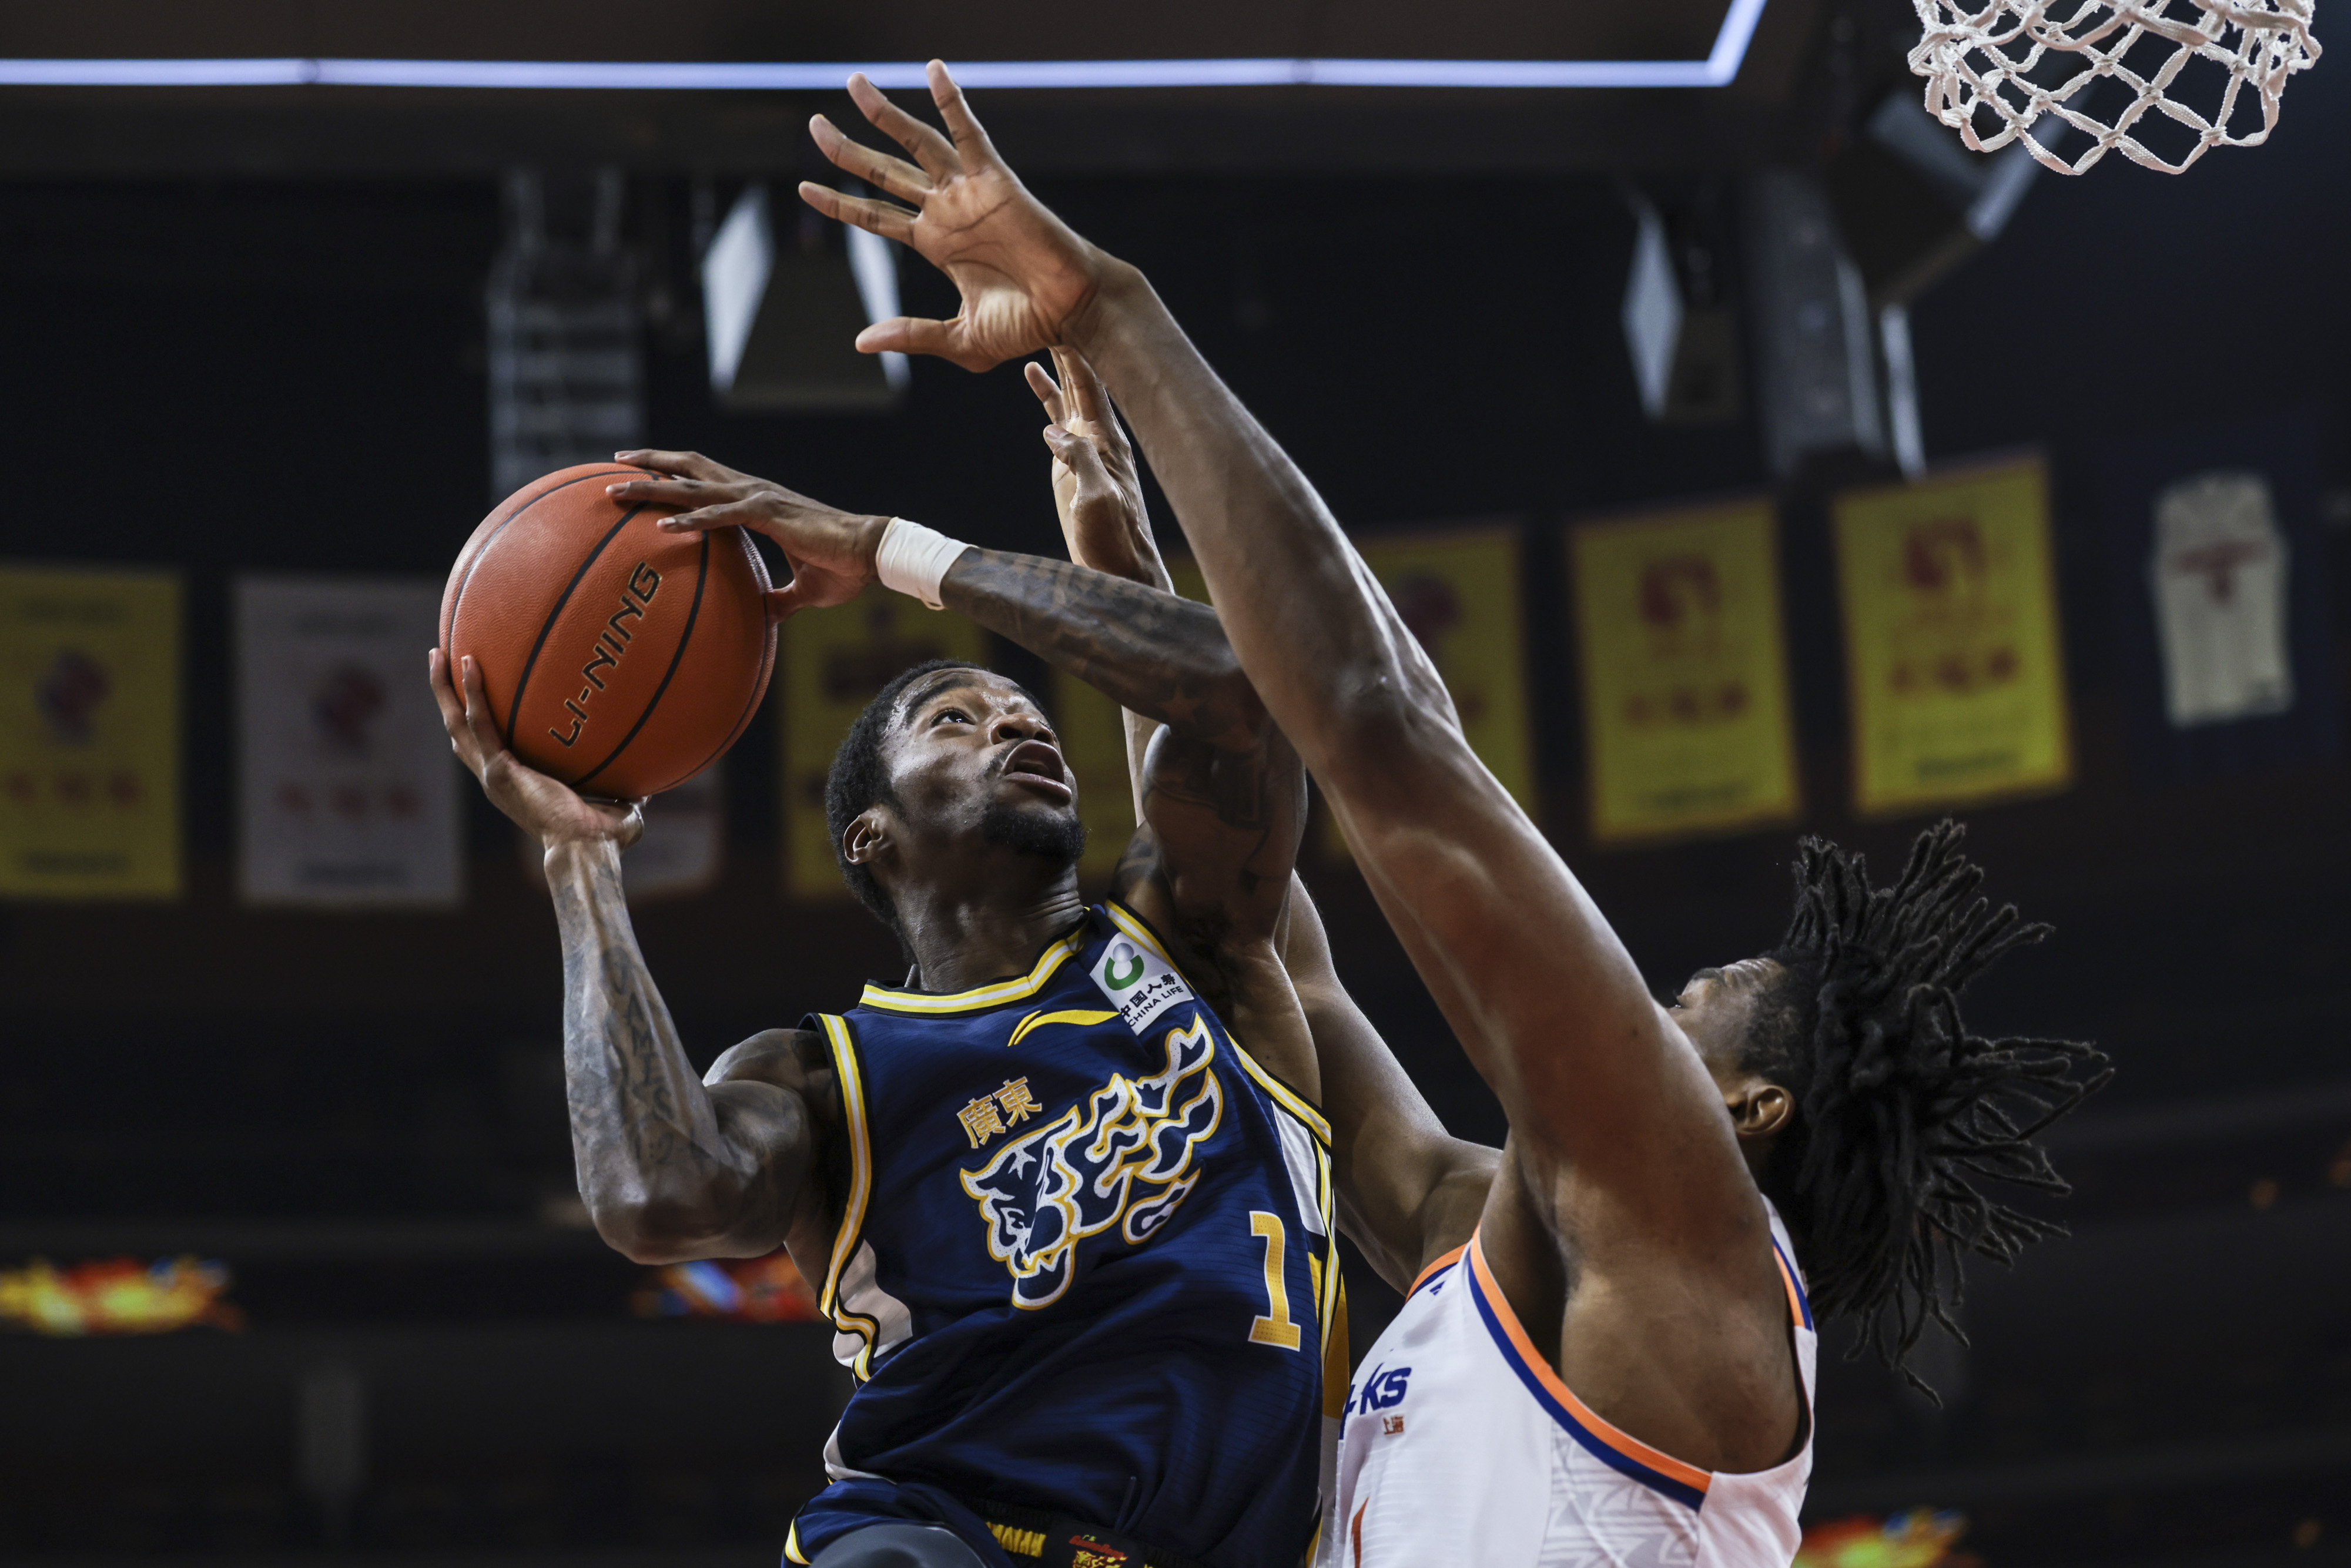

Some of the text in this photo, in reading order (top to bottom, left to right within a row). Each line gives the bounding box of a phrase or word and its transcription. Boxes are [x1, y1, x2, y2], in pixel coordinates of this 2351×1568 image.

[548, 560, 662, 749] LI-NING
[1120, 973, 1176, 1018] 中国人寿
[1127, 986, 1184, 1027] CHINA LIFE
[956, 1076, 1043, 1149] 廣東
[1248, 1211, 1301, 1352] 1
